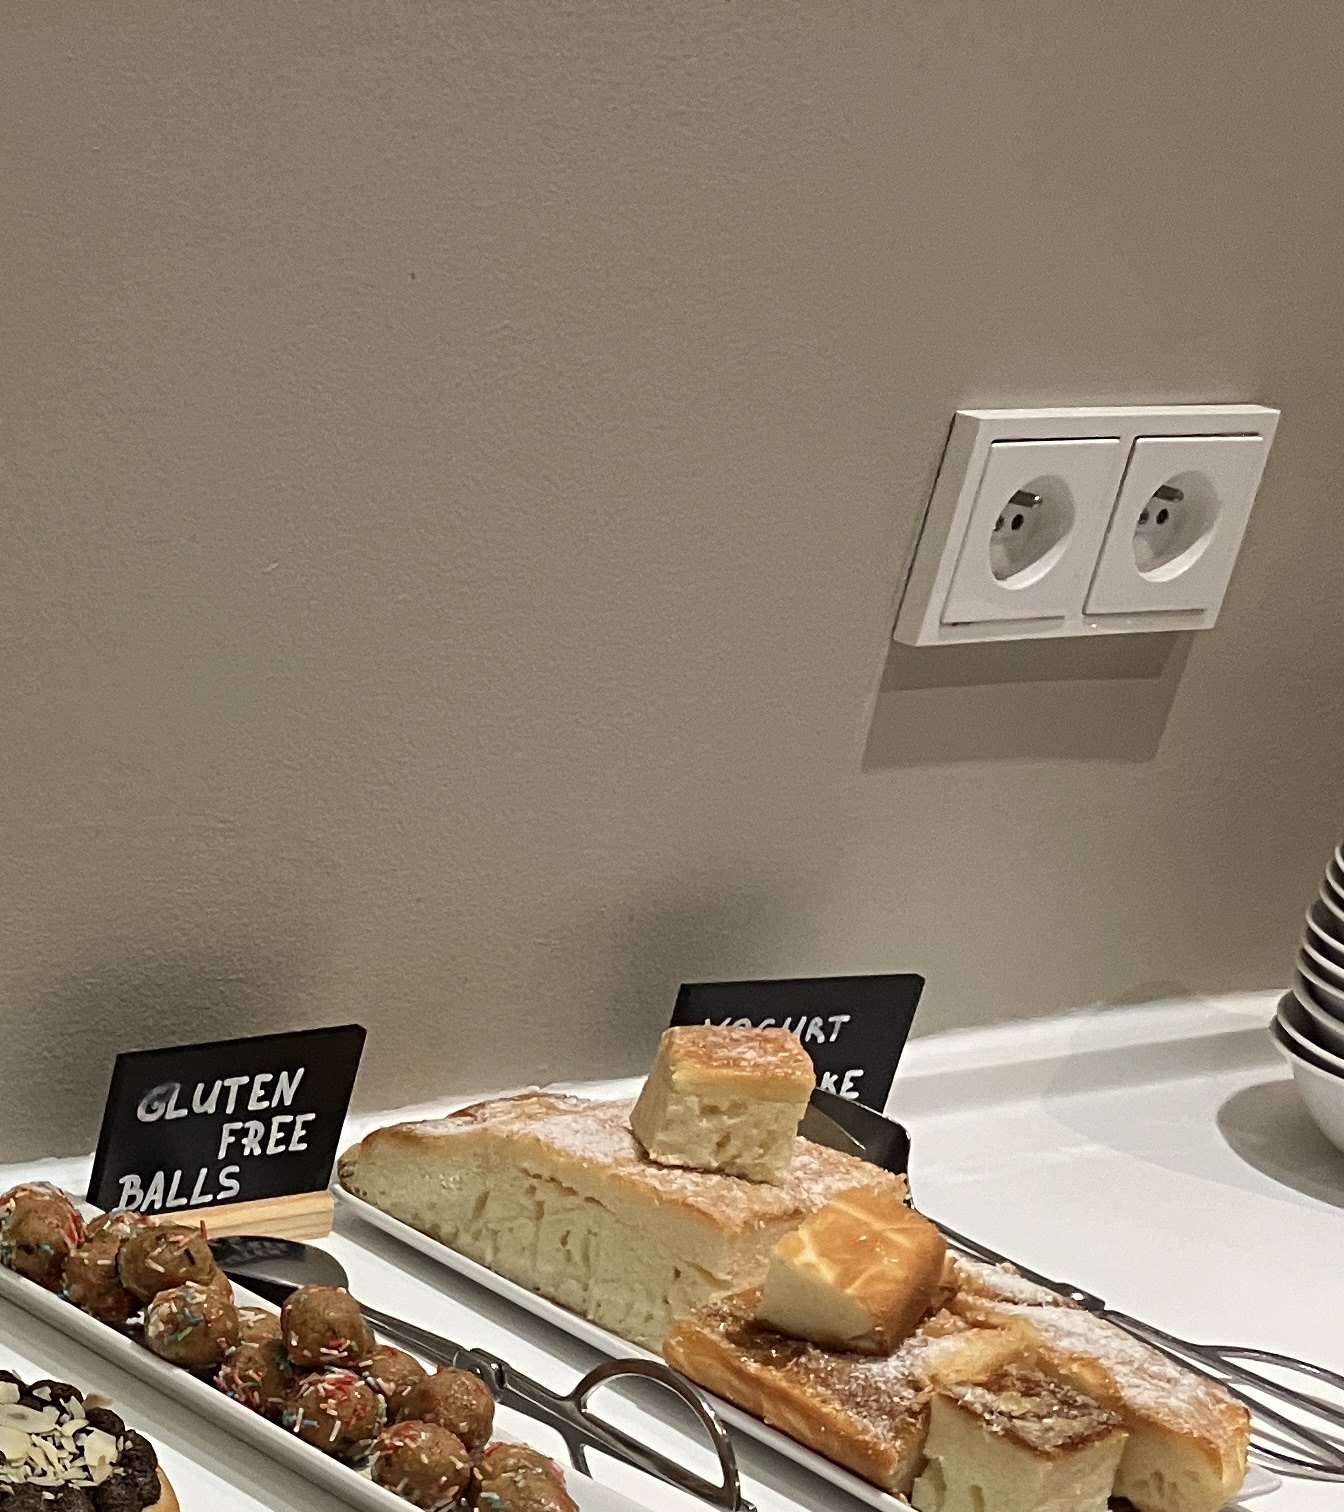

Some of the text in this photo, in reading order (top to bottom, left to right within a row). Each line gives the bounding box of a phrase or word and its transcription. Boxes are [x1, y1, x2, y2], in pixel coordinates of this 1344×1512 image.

[136, 1066, 305, 1123] GLUTEN
[217, 1112, 317, 1160] FREE
[114, 1164, 241, 1213] BALLS
